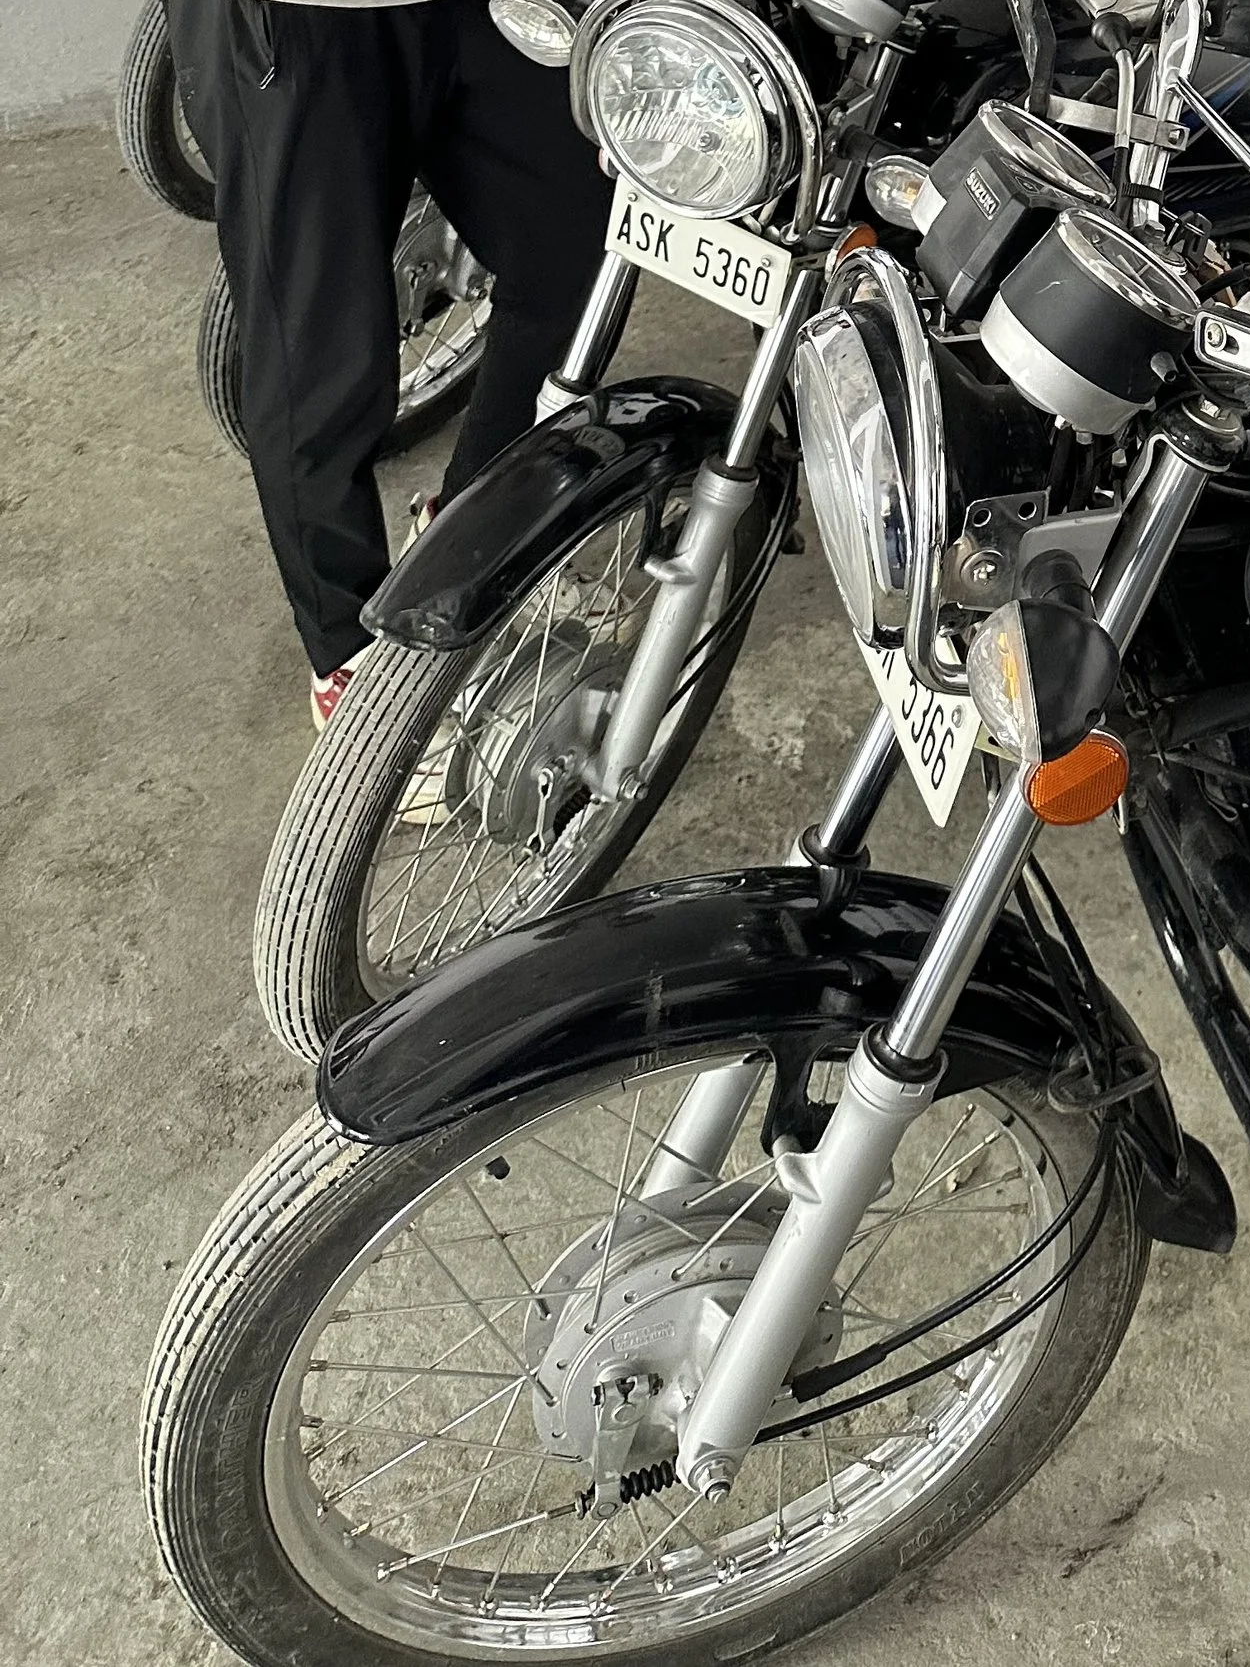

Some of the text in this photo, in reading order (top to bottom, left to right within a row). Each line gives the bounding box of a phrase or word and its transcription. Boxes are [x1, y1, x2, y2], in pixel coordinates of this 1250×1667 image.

[966, 172, 997, 214] SUZUKI
[617, 203, 770, 306] ASK 5360
